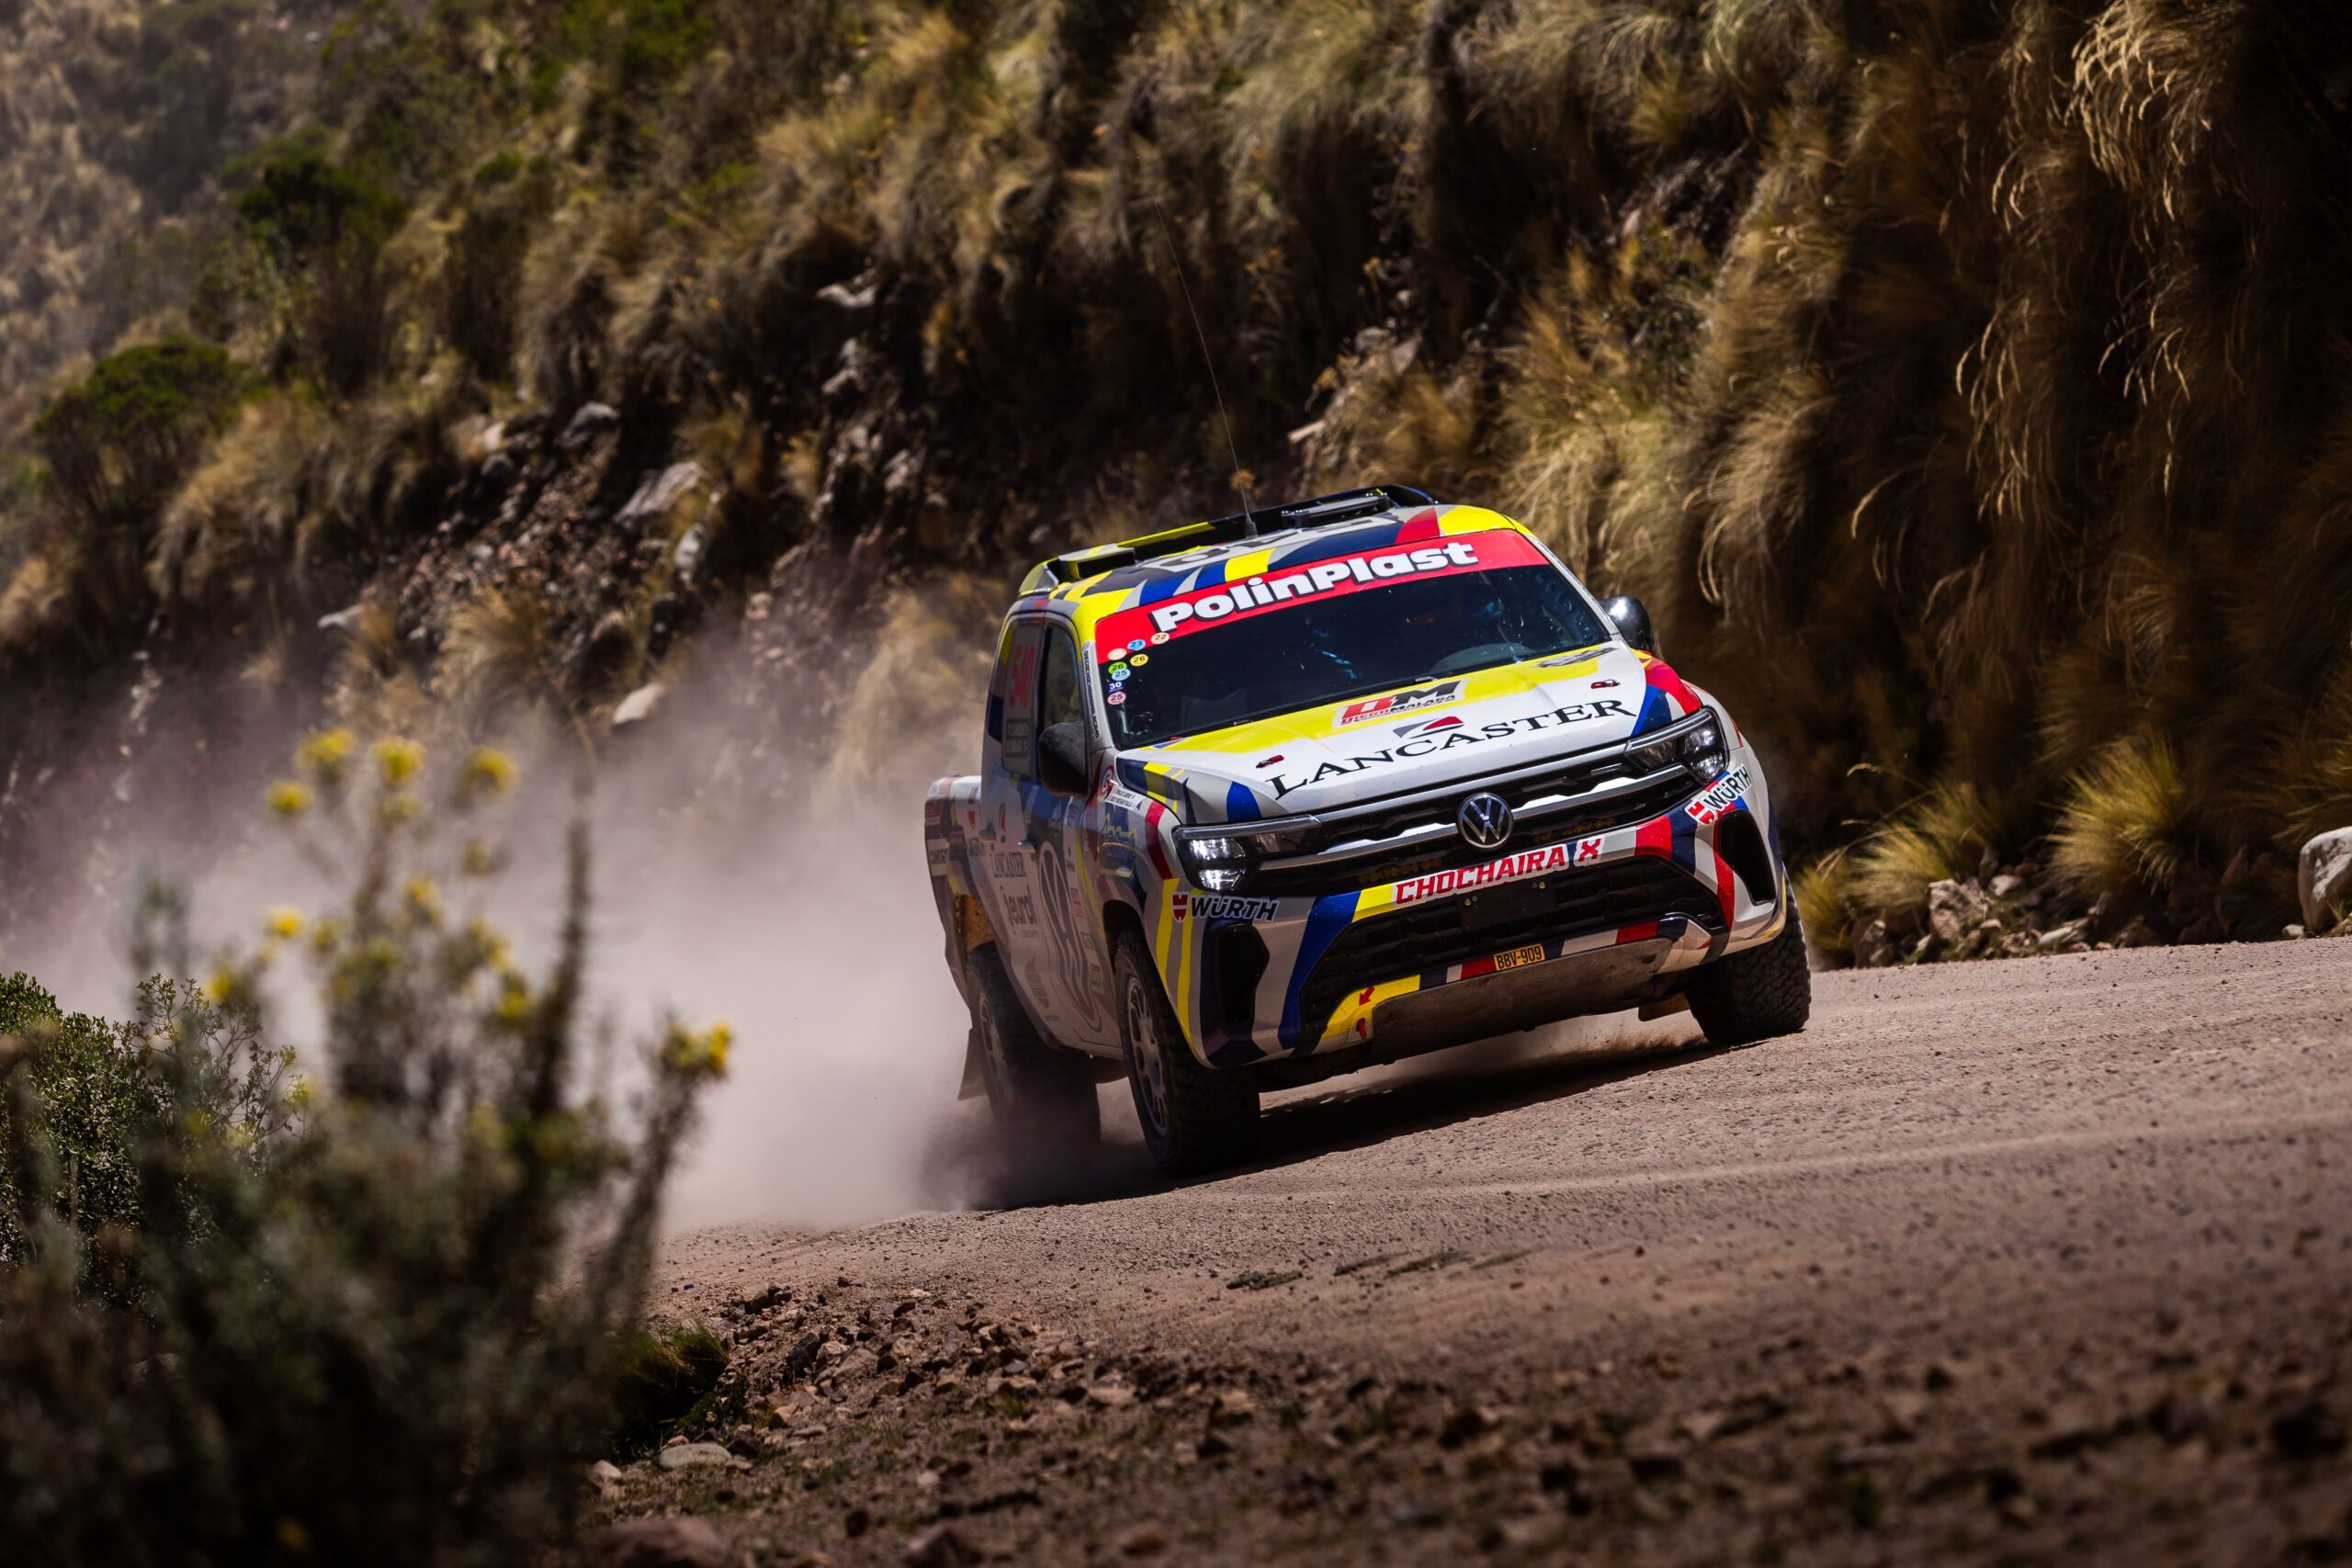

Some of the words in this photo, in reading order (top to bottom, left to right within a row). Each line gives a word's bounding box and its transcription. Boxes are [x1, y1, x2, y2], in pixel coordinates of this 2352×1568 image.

[1151, 542, 1478, 632] PolinPlast
[1110, 682, 1122, 690] 30
[1265, 699, 1637, 799] LANCASTER
[1703, 766, 1752, 810] WÜRTH
[1396, 846, 1566, 905] CHOCHAIRA
[1577, 838, 1602, 863] X
[1191, 896, 1279, 922] WÜRTH
[1496, 945, 1543, 970] BBV-909
